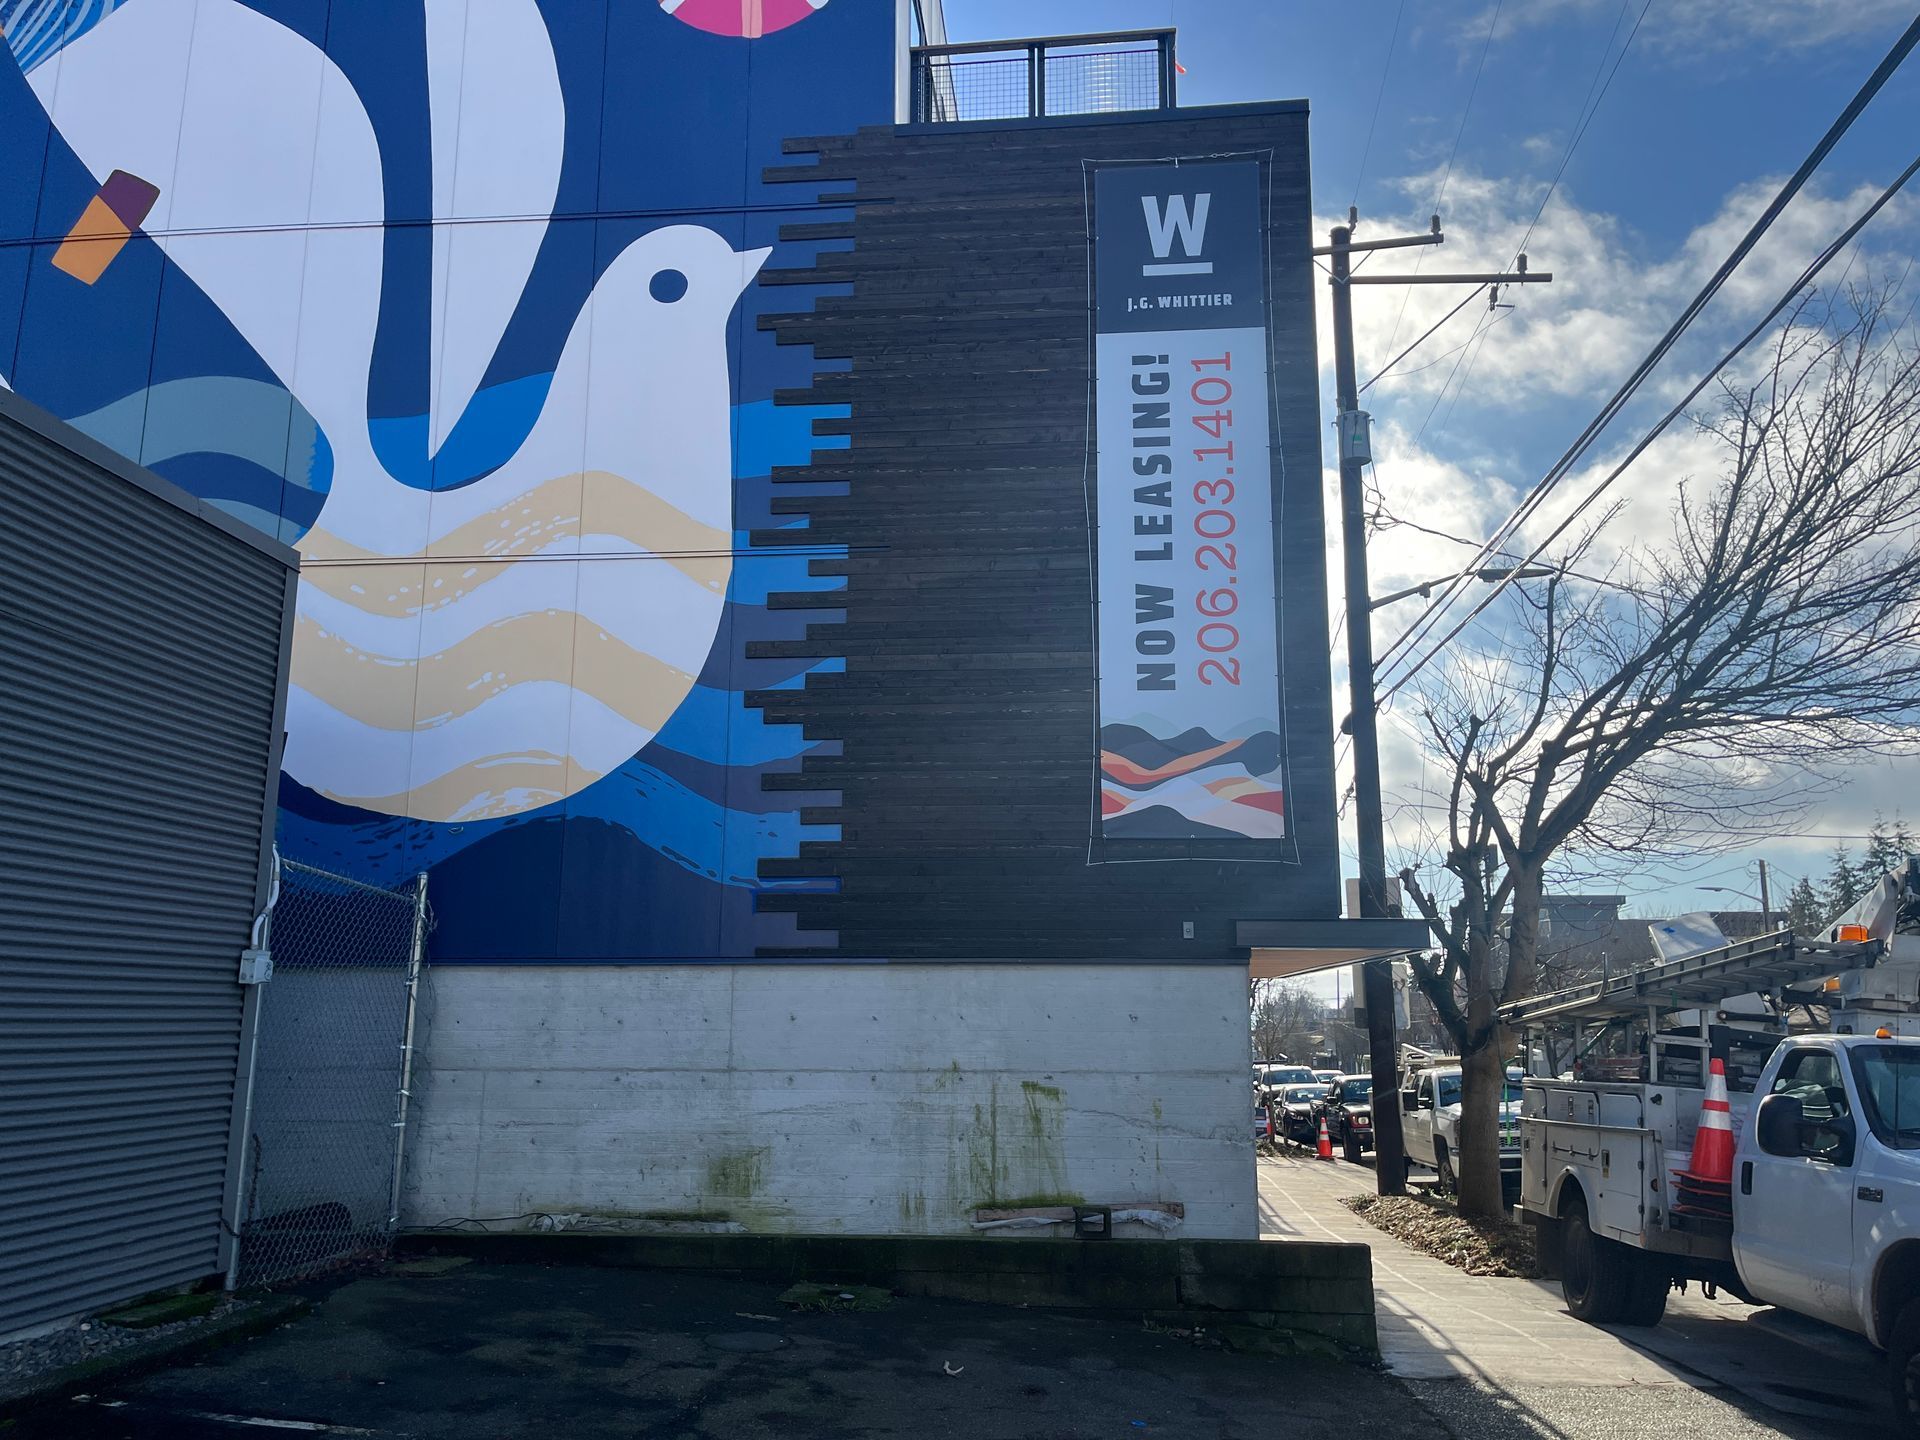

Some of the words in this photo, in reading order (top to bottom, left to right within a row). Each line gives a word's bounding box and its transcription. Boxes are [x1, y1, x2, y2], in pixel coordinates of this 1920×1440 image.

[1141, 193, 1211, 258] W
[1127, 297, 1153, 312] J.G.
[1157, 293, 1232, 308] WHITTIER
[1131, 354, 1173, 562] LEASING!
[1190, 351, 1241, 686] 206.203.1401
[1135, 583, 1176, 691] NOW
